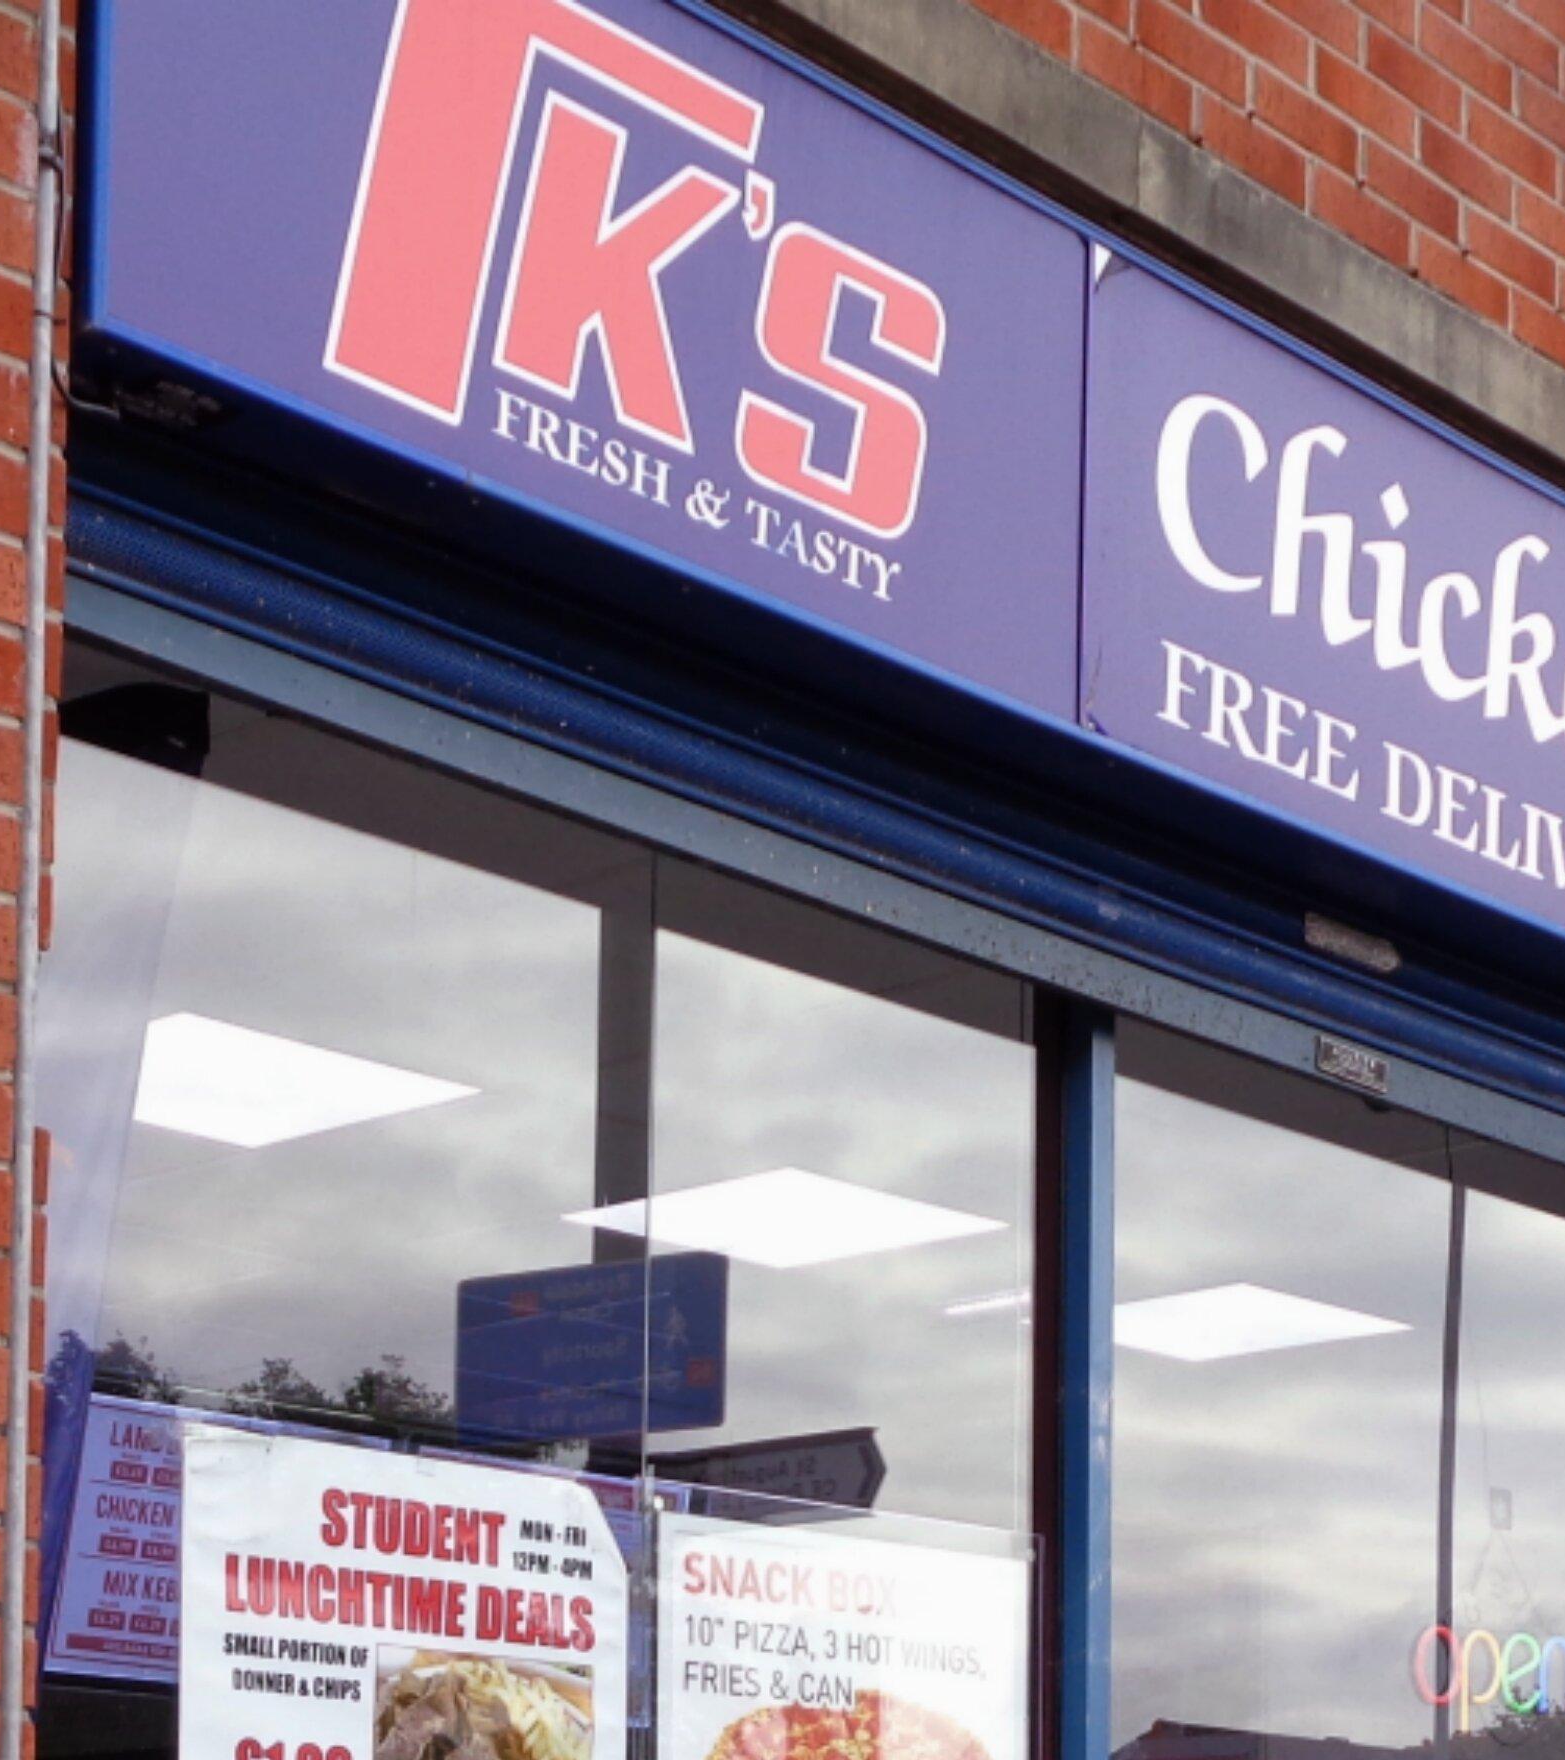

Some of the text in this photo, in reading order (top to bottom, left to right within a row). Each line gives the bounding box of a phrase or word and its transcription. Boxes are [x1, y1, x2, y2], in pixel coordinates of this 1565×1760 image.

[493, 388, 901, 602] FRESH & TASTY
[1157, 640, 1358, 801] FREE
[97, 1493, 176, 1528] CHICKEN
[321, 1488, 505, 1567] STUDENT
[519, 1518, 586, 1547] MON FRI
[103, 1570, 139, 1598] MIX
[513, 1551, 549, 1575] 12PM
[682, 1551, 897, 1617] SNACK BOX
[225, 1553, 596, 1652] LUNCHTIME DEALS
[224, 1632, 369, 1668] SMALL PORTION OF
[685, 1613, 987, 1682] 10" PIZZA, 3 HOT WINGS,
[232, 1668, 361, 1702] DONNER & CHIPS
[683, 1661, 854, 1707] FRIES & CAN
